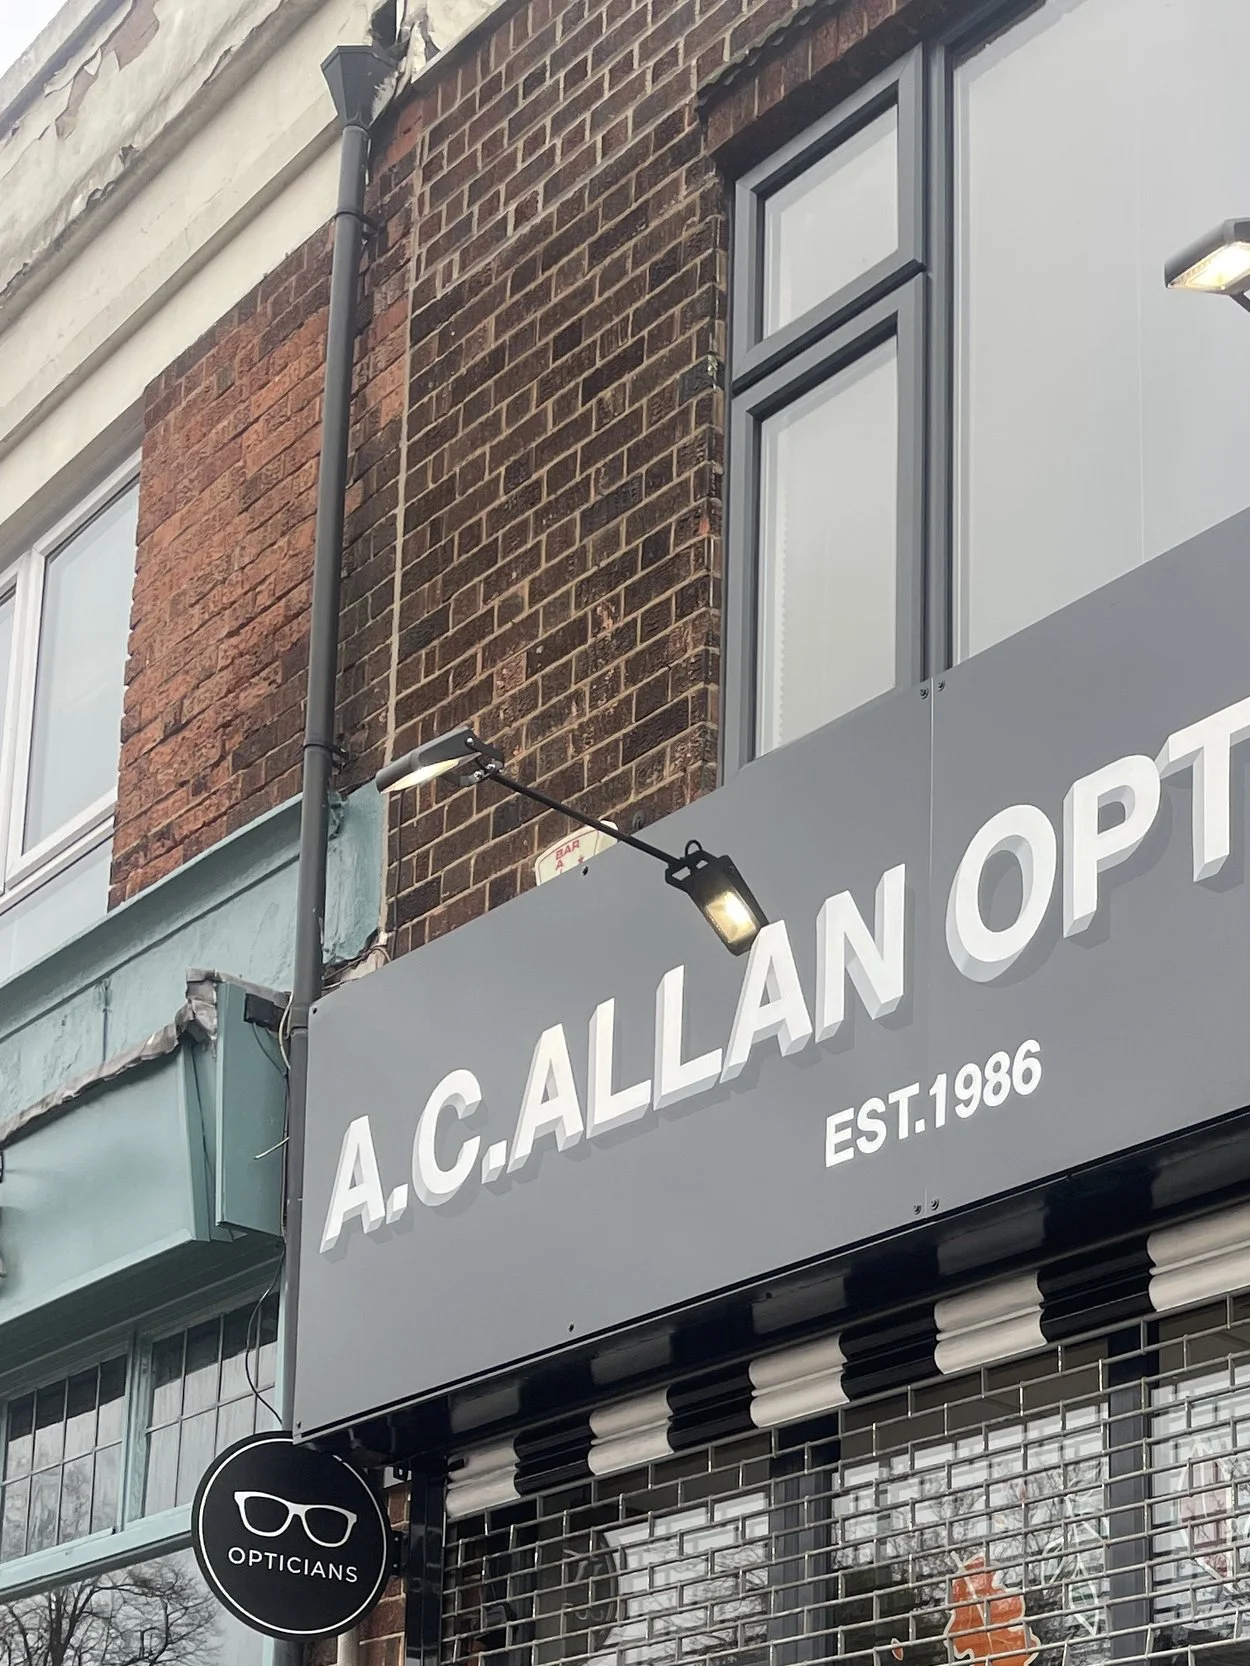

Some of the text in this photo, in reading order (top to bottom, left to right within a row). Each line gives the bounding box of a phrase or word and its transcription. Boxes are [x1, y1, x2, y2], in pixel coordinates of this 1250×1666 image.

[555, 839, 580, 861] BAR
[825, 1038, 1043, 1168] EST.1986
[228, 1546, 358, 1583] OPTICIANS
